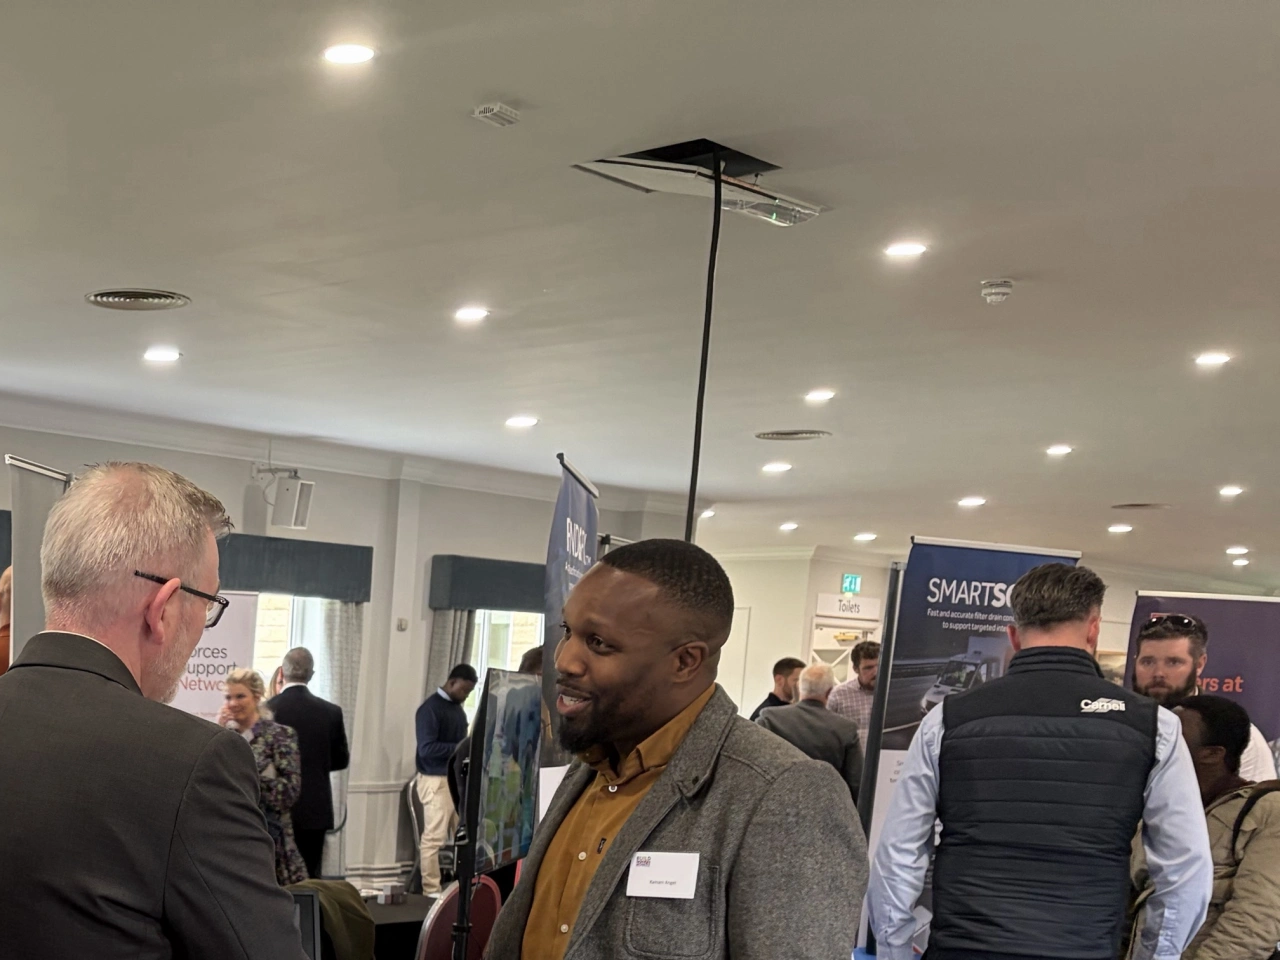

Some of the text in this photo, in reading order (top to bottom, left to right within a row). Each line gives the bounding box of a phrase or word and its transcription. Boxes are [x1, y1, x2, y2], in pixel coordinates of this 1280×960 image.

[838, 599, 861, 614] Toilets
[927, 607, 939, 617] Fast
[939, 610, 951, 618] and
[951, 611, 973, 620] accurate
[974, 612, 988, 620] filter
[988, 613, 1003, 621] drain
[942, 621, 949, 629] to
[949, 622, 971, 631] support
[971, 623, 996, 633] targeted
[190, 647, 228, 659] orces
[187, 661, 237, 678] upport
[180, 676, 226, 692] Netwo
[1196, 676, 1244, 693] ers at
